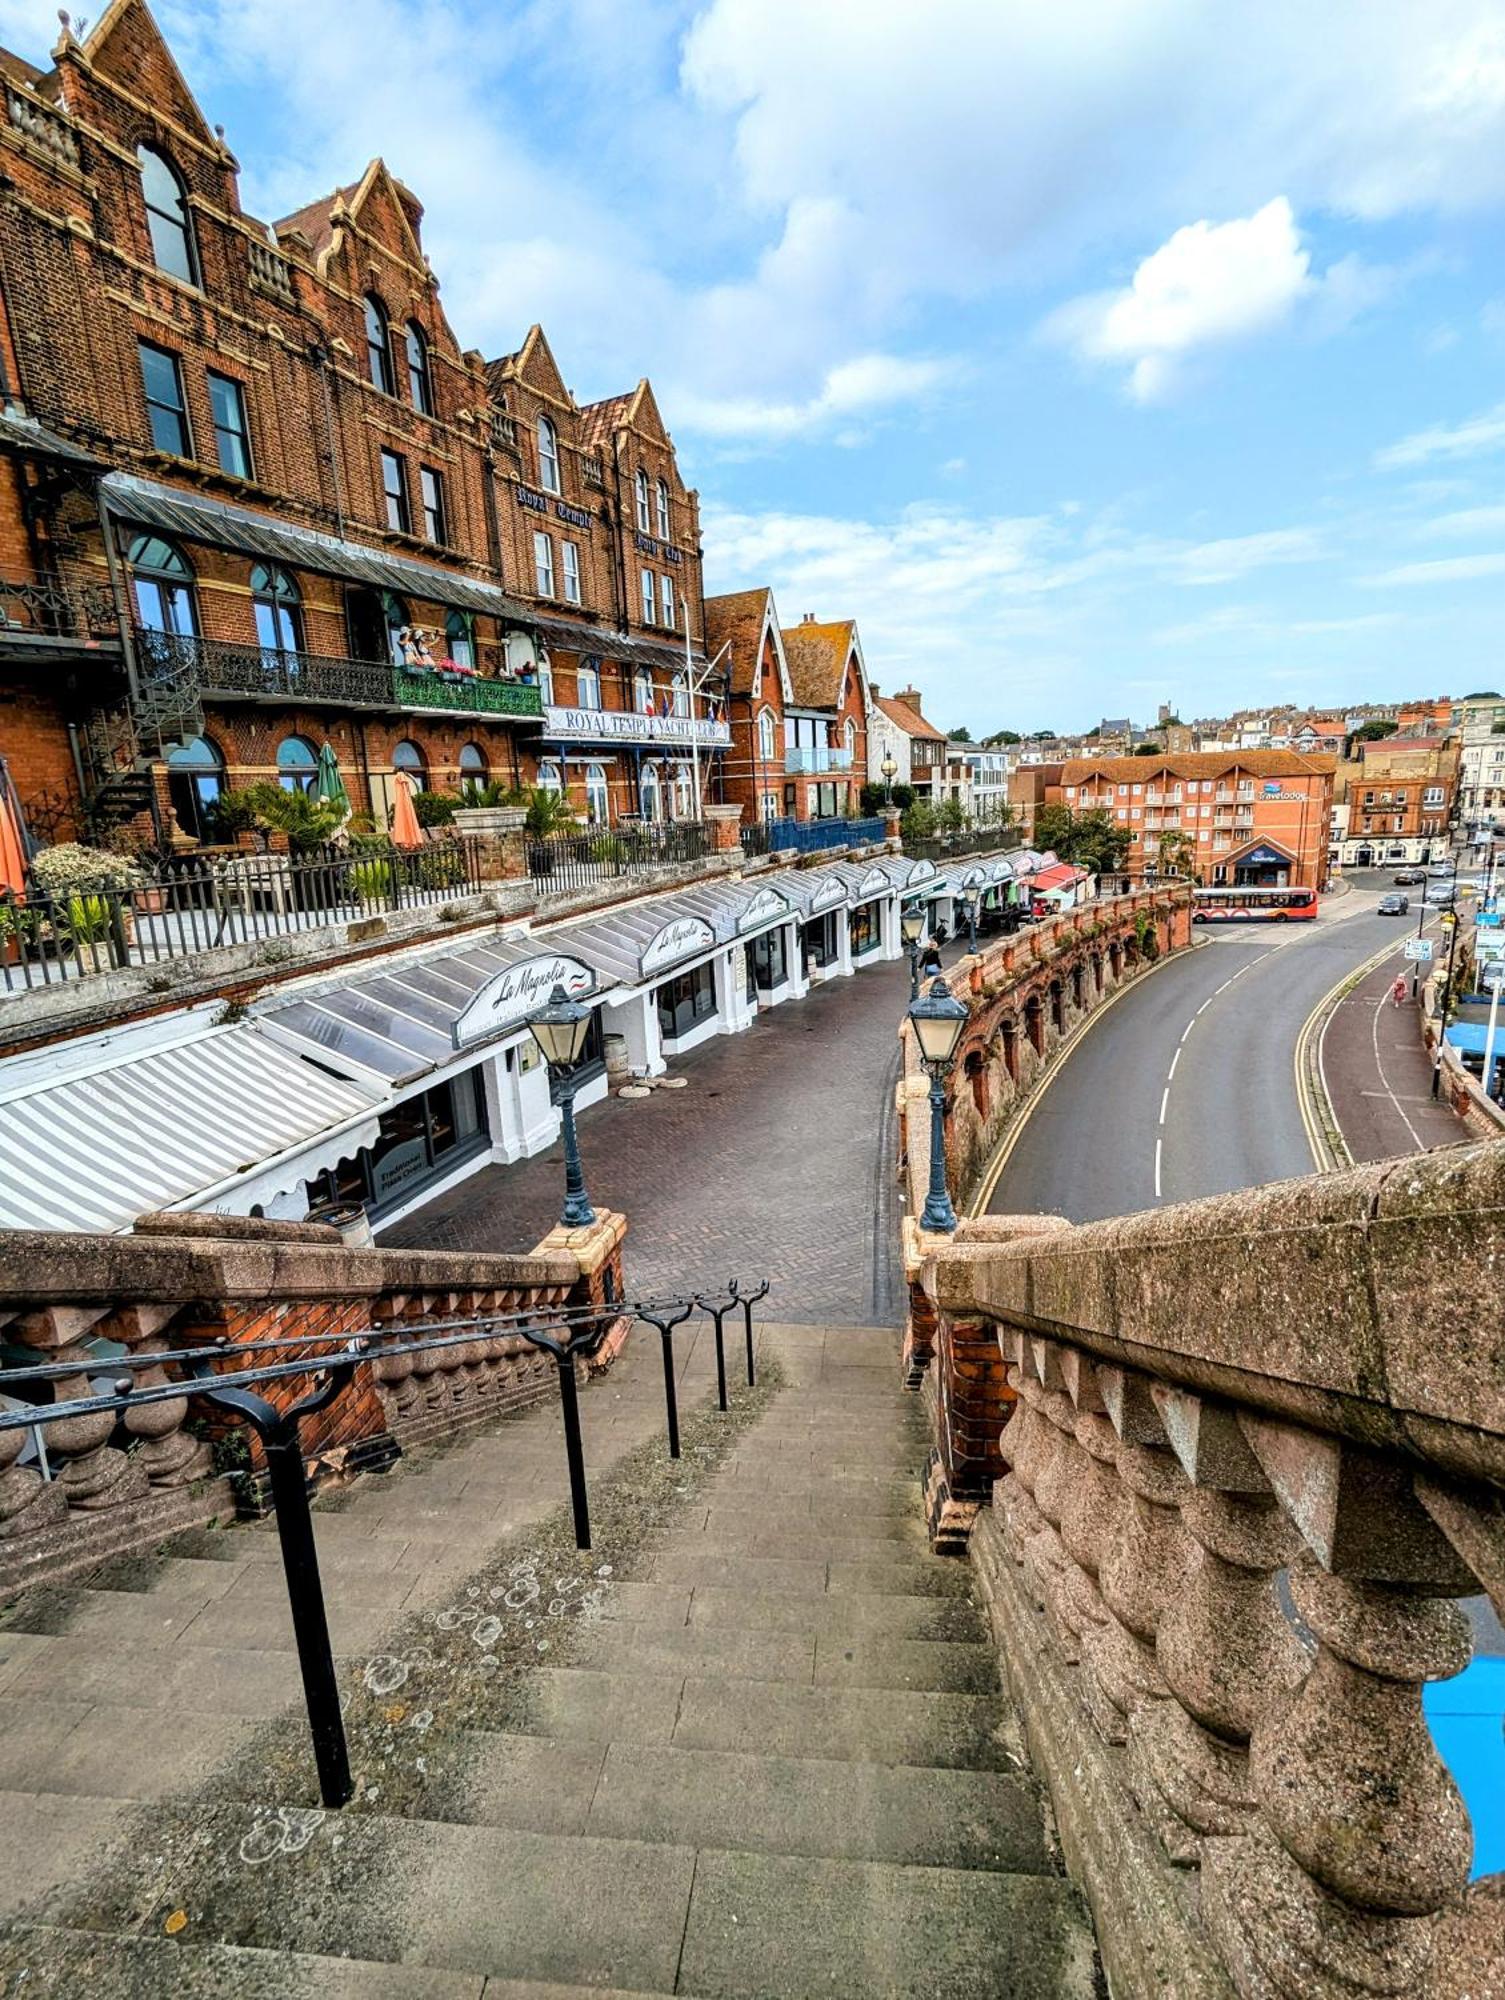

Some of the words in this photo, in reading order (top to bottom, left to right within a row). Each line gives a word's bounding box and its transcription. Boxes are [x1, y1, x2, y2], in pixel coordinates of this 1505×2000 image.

[517, 486, 548, 512] Royal
[557, 502, 592, 528] Temple
[565, 711, 610, 732] ROYAL
[611, 716, 656, 734] TEMPLE
[658, 718, 690, 736] YACHT
[1258, 790, 1310, 801] Travelodge
[657, 929, 669, 952] La
[671, 920, 698, 949] Magnolia
[492, 974, 513, 1010] La
[514, 960, 567, 1001] Magnolia
